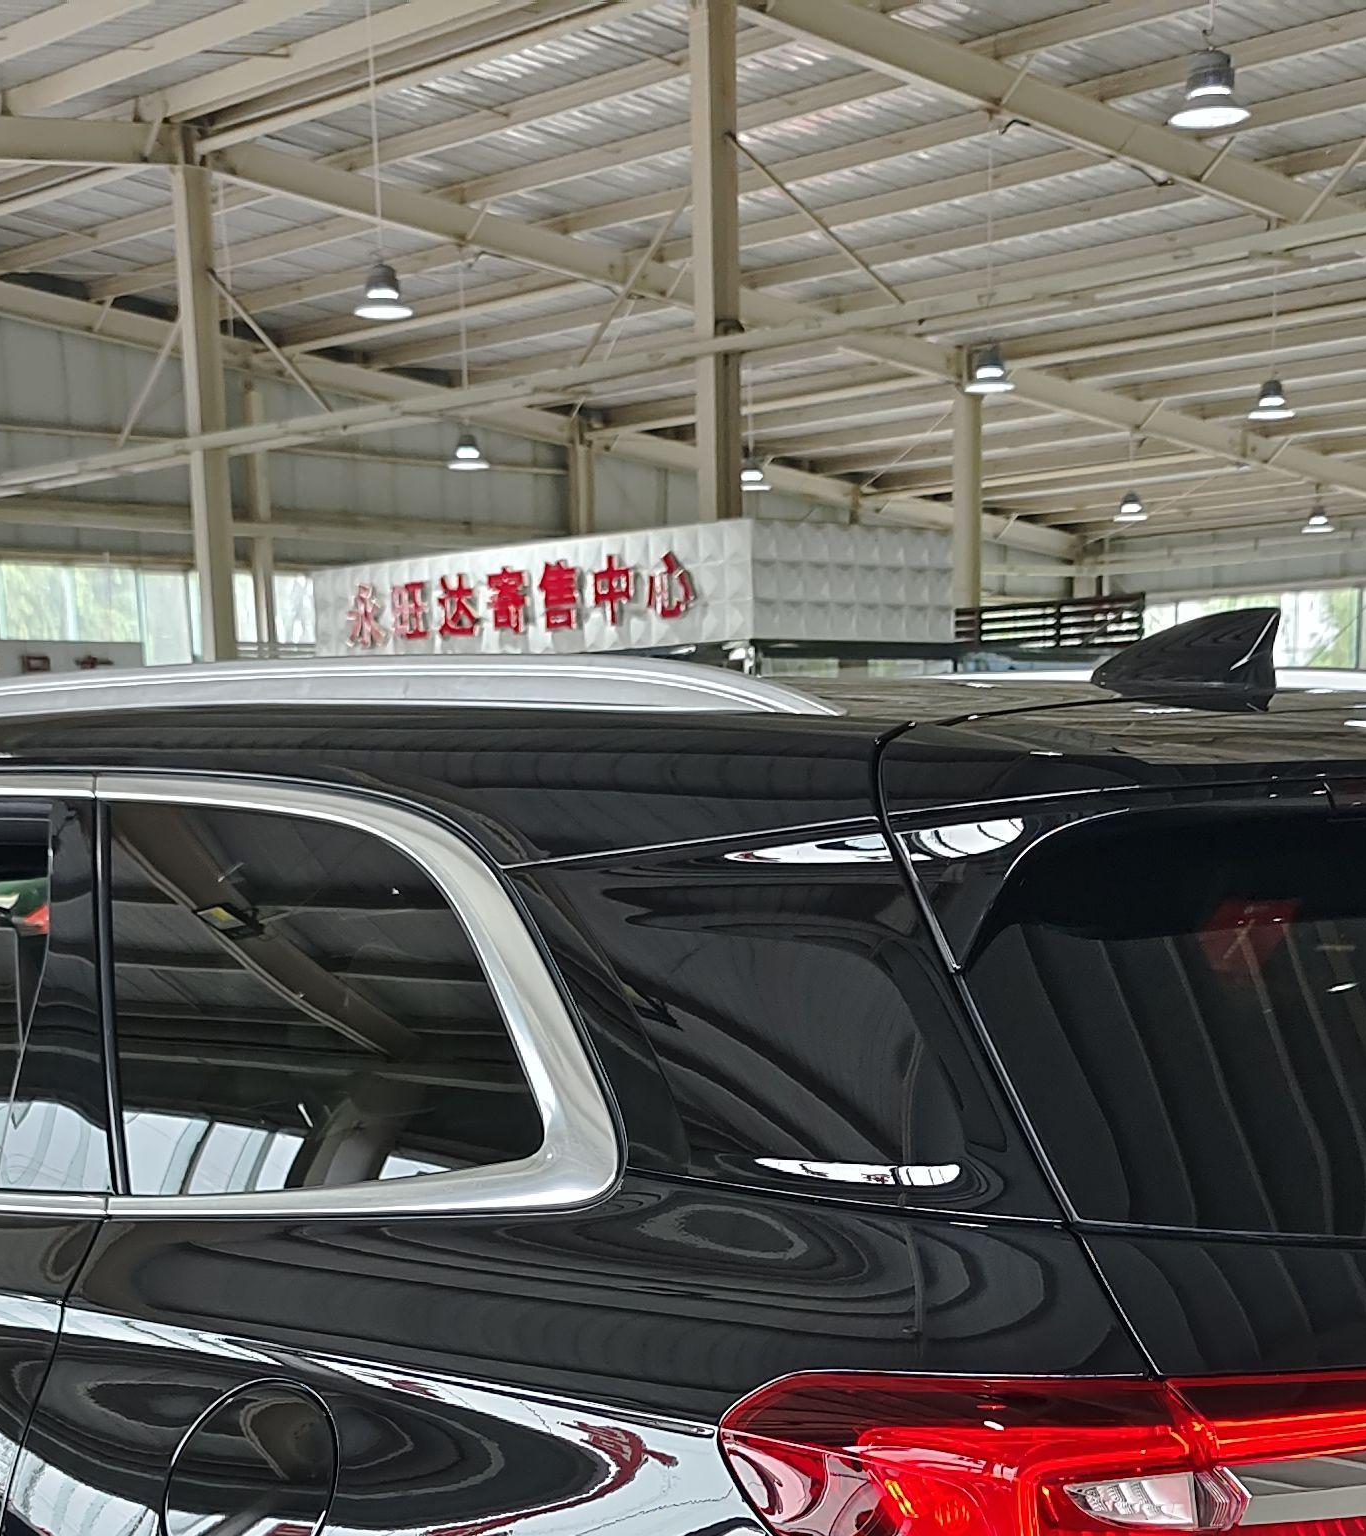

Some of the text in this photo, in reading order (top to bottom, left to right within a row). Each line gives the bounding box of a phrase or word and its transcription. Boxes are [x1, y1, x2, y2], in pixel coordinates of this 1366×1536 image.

[347, 551, 697, 649] 永旺达寄售中心
